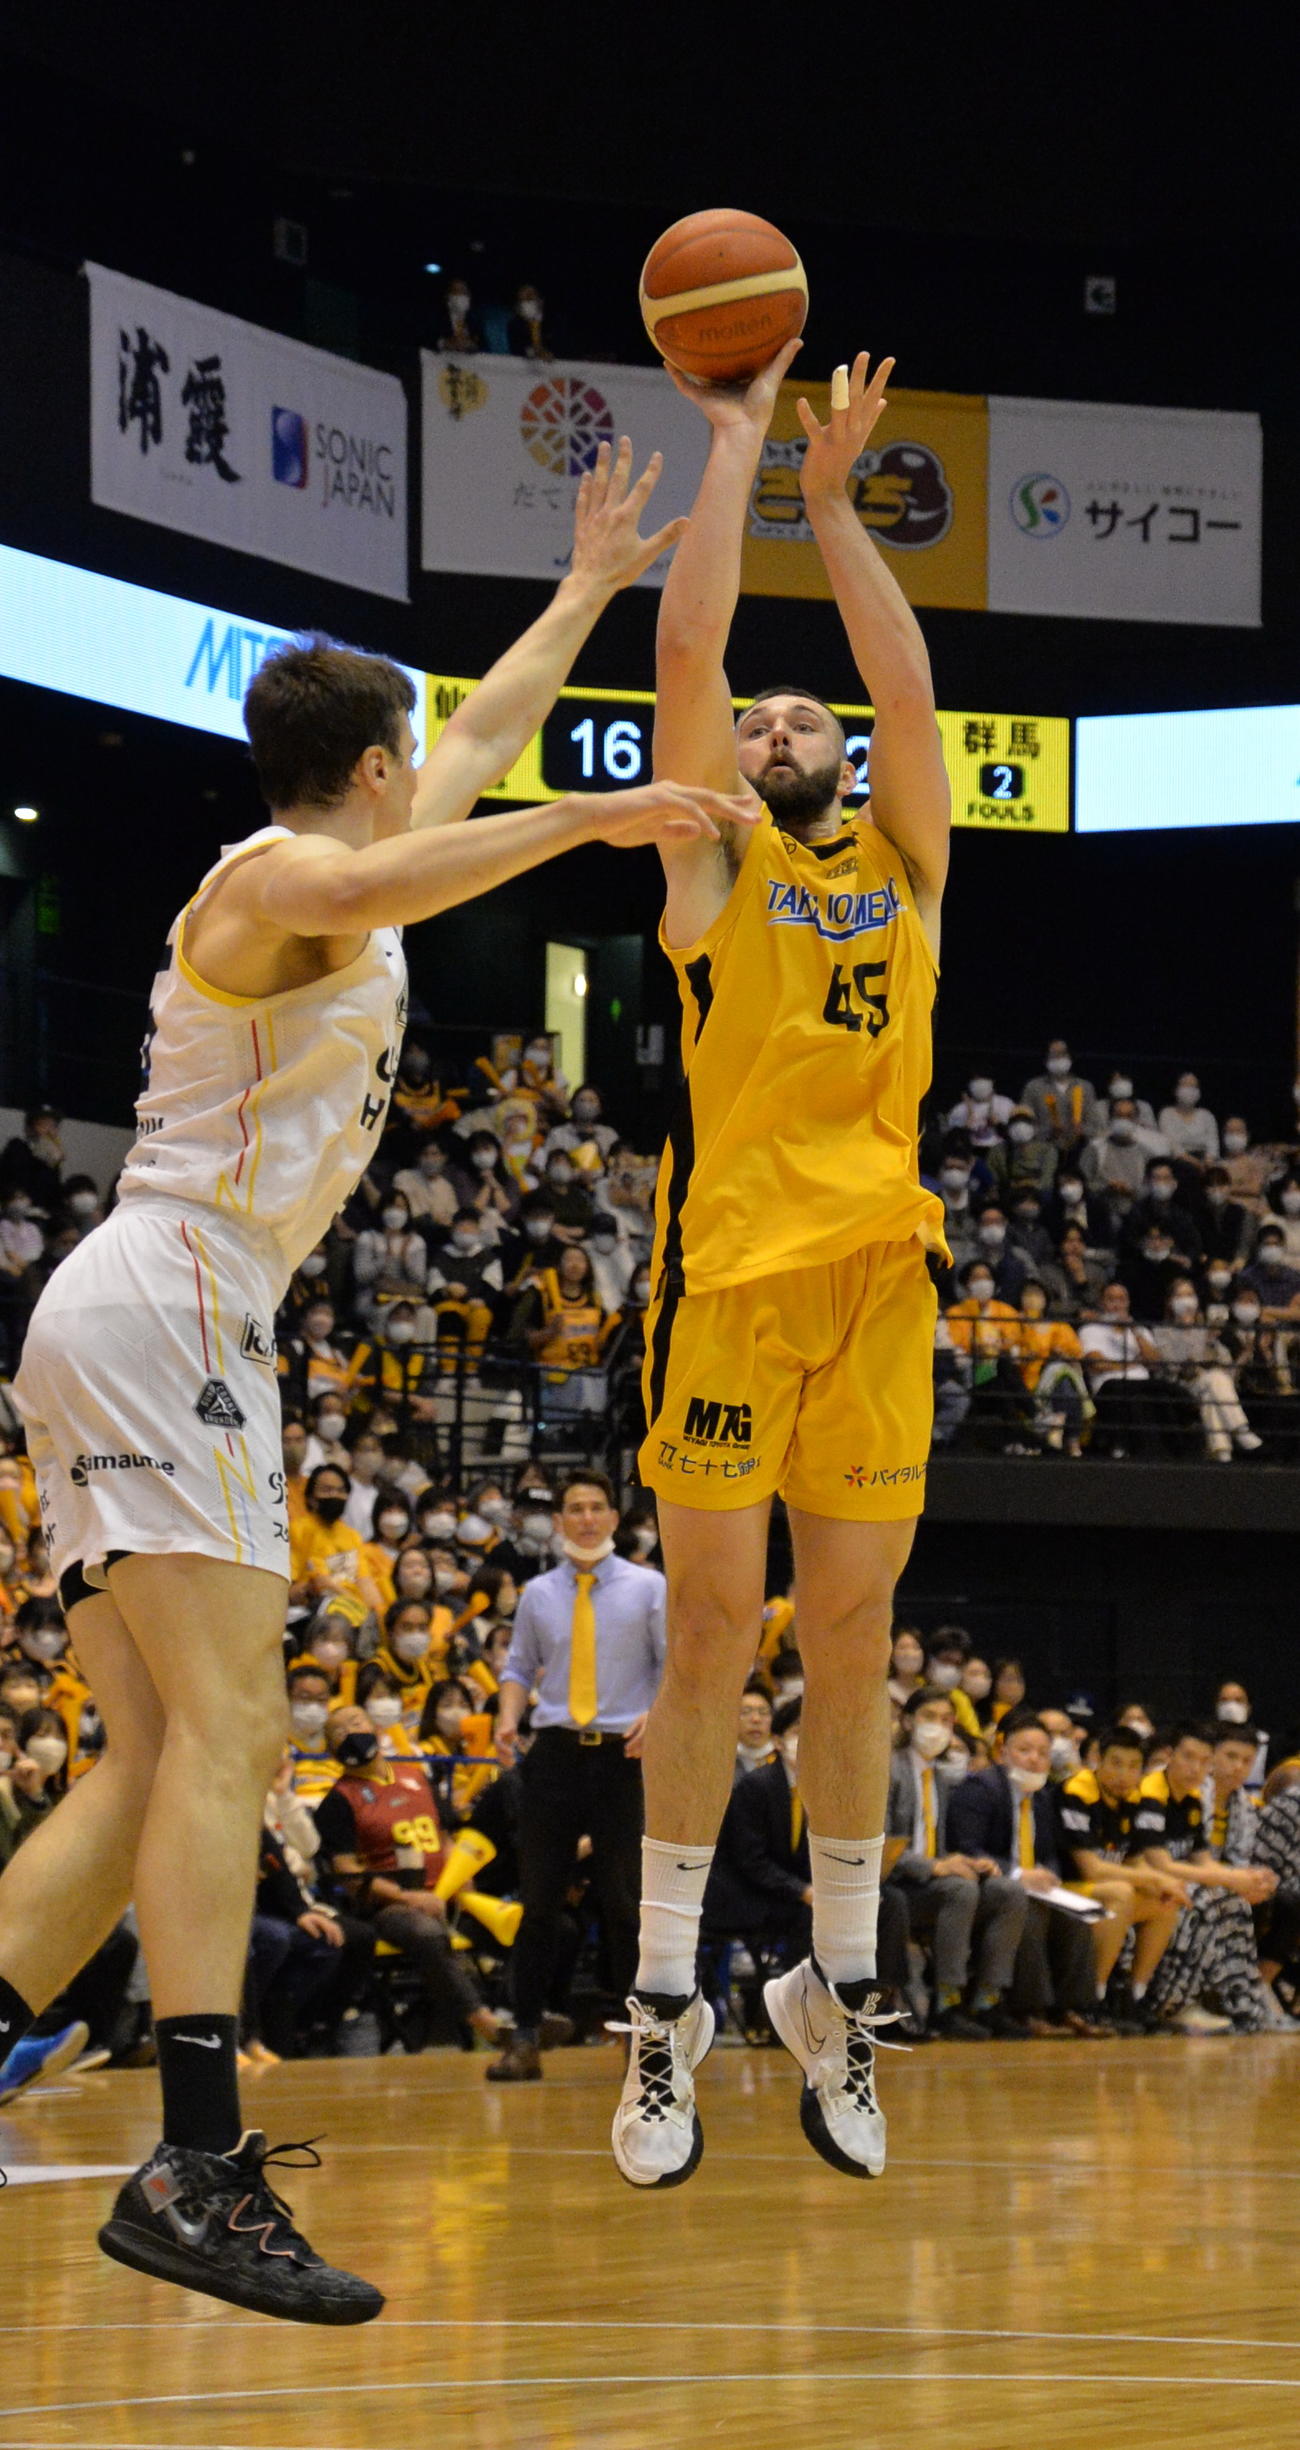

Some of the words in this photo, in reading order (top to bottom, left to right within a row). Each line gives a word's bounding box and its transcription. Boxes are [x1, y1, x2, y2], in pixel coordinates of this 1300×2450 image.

[700, 311, 772, 341] molten
[315, 422, 393, 481] SONIC
[321, 462, 395, 518] JAPAN
[1085, 500, 1242, 543] サイコー
[185, 617, 288, 701] MIT
[570, 718, 642, 780] 16
[964, 720, 1040, 760] 群馬
[993, 766, 1013, 799] 2
[967, 803, 1034, 822] FOULS
[823, 961, 890, 1038] 45
[683, 1397, 752, 1442] MTG
[391, 1816, 440, 1854] 99
